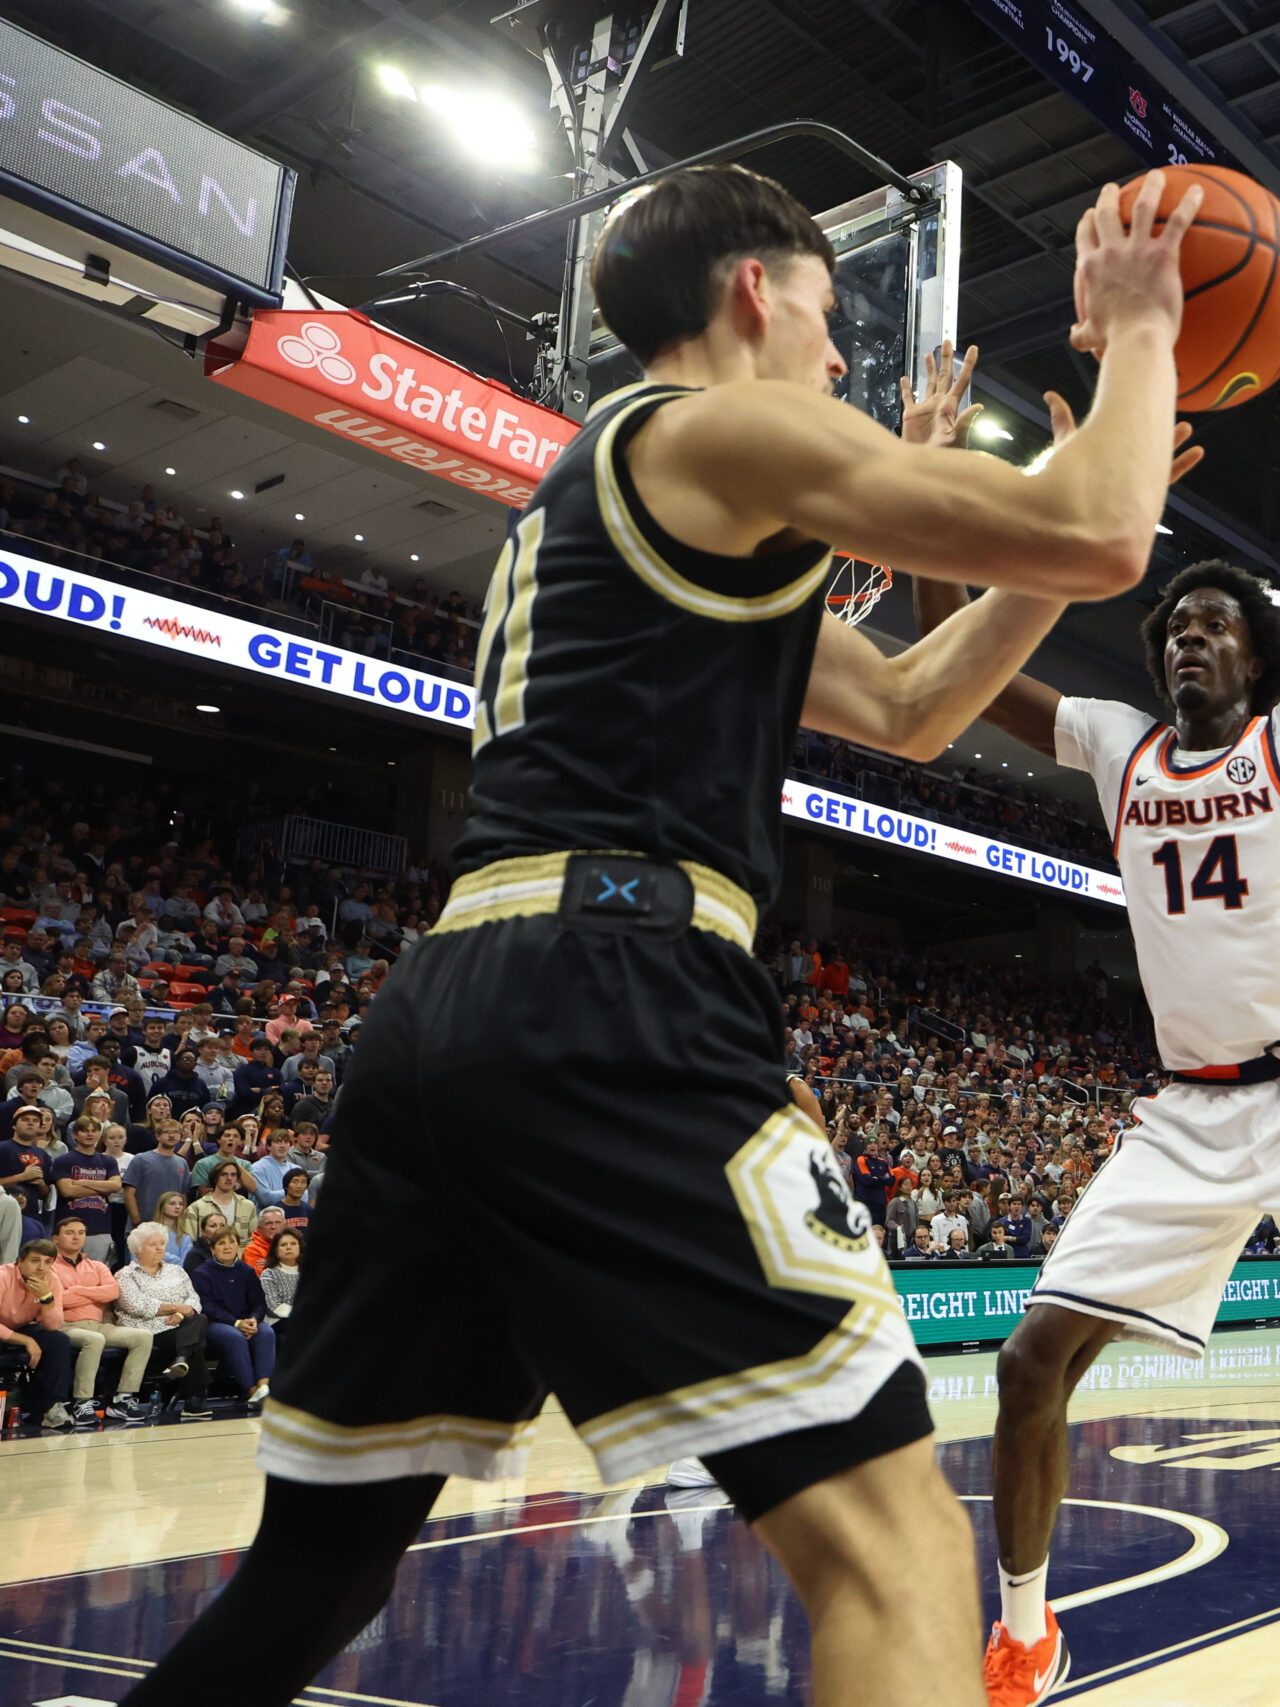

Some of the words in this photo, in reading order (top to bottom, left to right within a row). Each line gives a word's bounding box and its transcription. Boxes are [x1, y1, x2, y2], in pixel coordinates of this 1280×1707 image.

[1046, 26, 1095, 83] 1997
[0, 74, 258, 237] SAN
[314, 409, 464, 471] Farm
[361, 354, 487, 442] State
[488, 408, 566, 470] Far
[248, 634, 342, 685] GET
[352, 662, 472, 720] LOUD
[1229, 760, 1254, 781] SEC
[805, 792, 857, 828] GET
[862, 804, 936, 851] LOUD!
[1124, 787, 1273, 826] AUBURN
[985, 845, 1025, 875] GET
[1031, 855, 1090, 892] LOUD!
[1152, 834, 1249, 915] 14
